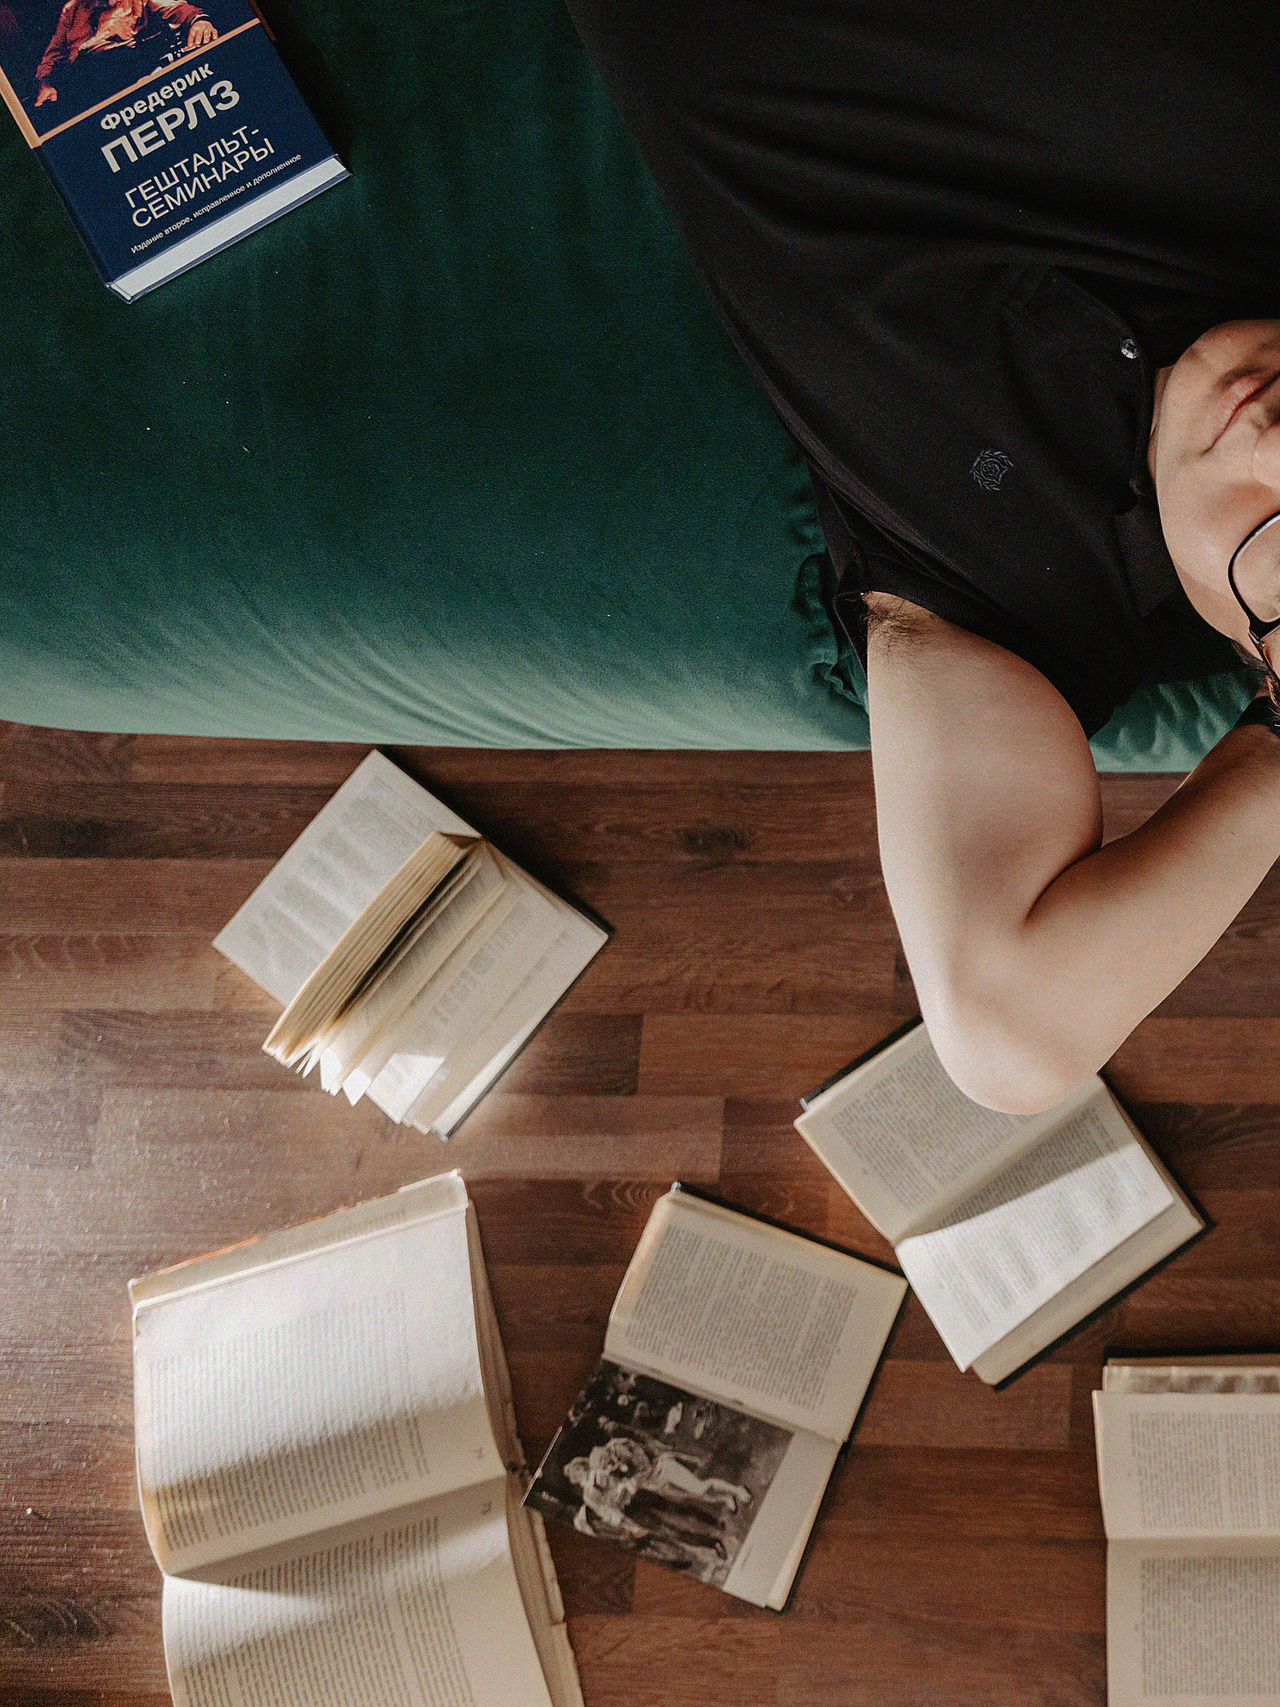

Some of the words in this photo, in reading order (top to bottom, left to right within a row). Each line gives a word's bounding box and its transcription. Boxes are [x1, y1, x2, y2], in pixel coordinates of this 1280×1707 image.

[100, 63, 214, 131] Фредерик
[100, 79, 240, 173] ПЕРЛЗ
[125, 125, 260, 208] ГЕШТАЛЬТ-
[130, 231, 164, 254] Издание
[164, 216, 194, 236] второе,
[192, 185, 246, 219] исправленное
[252, 154, 302, 186] дополненное
[132, 138, 275, 228] СЕМИНАРЫ
